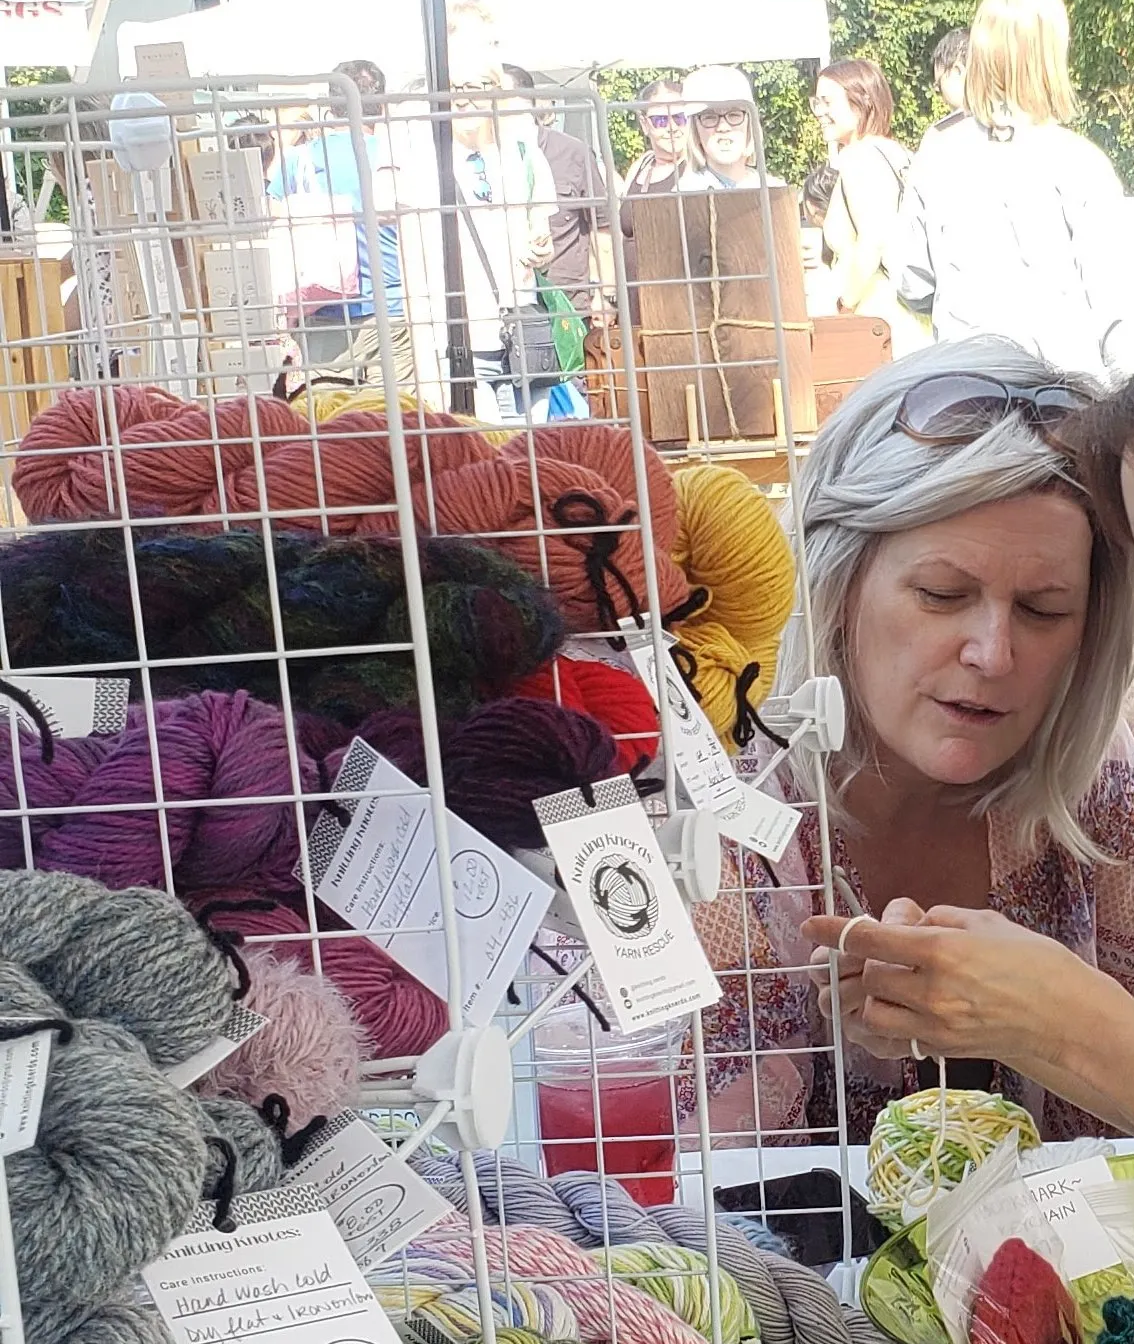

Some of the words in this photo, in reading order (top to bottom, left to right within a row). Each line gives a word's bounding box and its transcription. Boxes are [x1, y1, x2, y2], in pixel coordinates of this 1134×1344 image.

[571, 836, 606, 884] Knitting
[613, 943, 642, 961] YARN
[641, 928, 677, 960] RESCUE
[233, 1227, 303, 1248] Knotes:
[159, 1277, 189, 1291] Care
[190, 1264, 267, 1285] Instructions:
[175, 1287, 228, 1318] Hand
